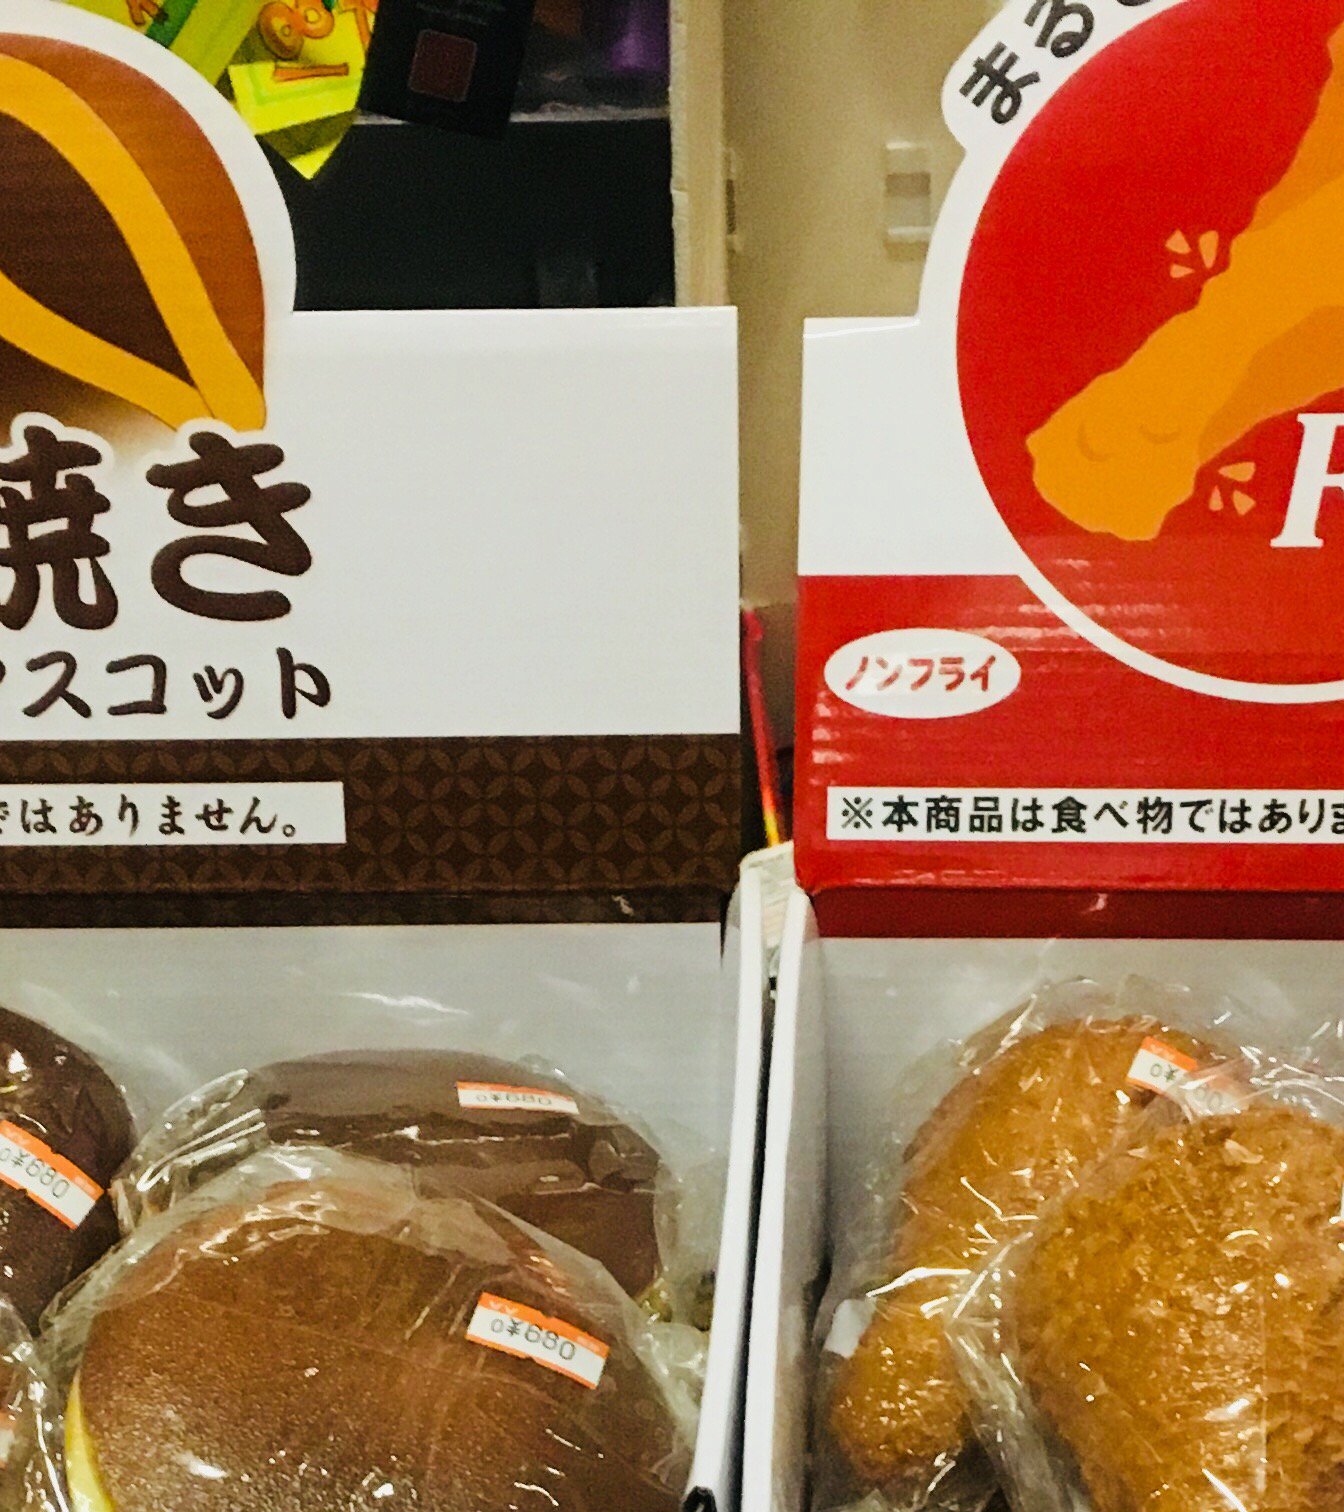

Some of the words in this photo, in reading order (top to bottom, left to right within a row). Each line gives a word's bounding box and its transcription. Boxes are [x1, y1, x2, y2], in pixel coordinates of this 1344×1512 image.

[844, 655, 999, 694] ノンフライ
